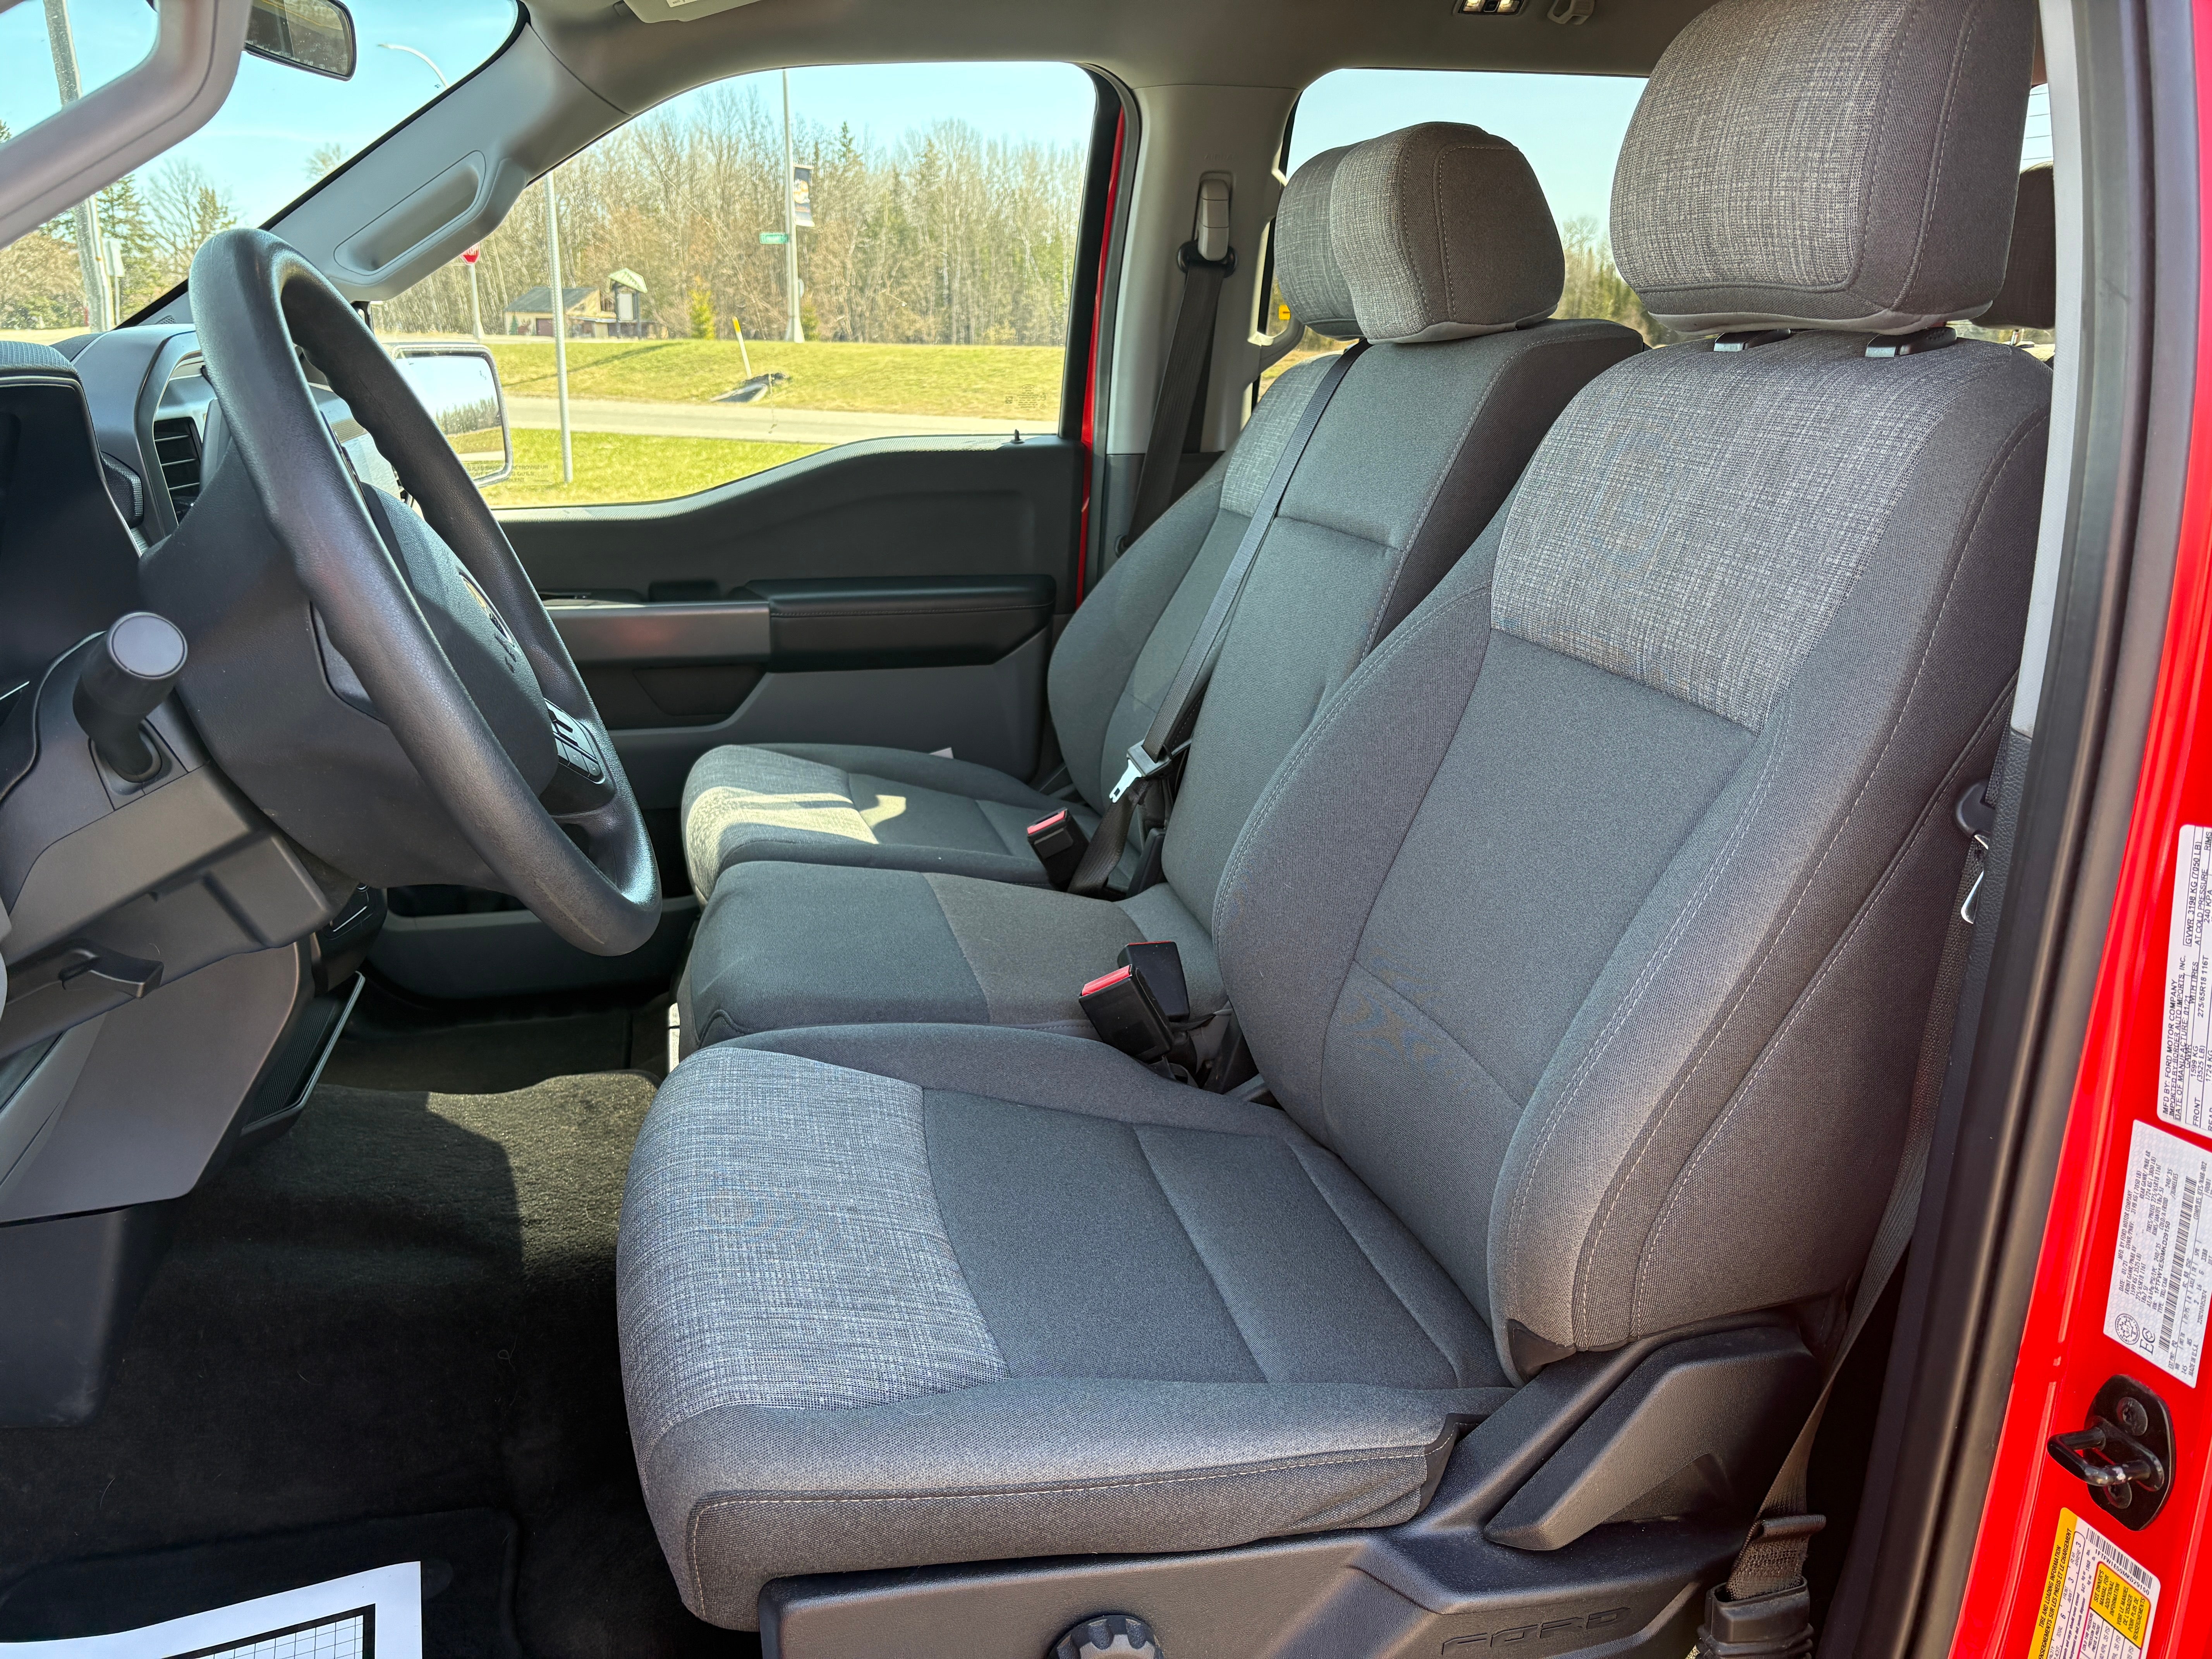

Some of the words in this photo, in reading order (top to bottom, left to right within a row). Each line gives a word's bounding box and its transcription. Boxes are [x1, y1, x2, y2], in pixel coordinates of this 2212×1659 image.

[2203, 831, 2212, 851] RIMS
[2191, 857, 2200, 879] (7050
[2190, 881, 2197, 894] KG
[2197, 868, 2208, 910] PRESSURE
[2188, 896, 2196, 915] 3198
[2185, 918, 2193, 945] GVWR
[2195, 911, 2204, 934] COLD
[2194, 934, 2202, 946] AT
[2191, 961, 2199, 982] TIRES
[2169, 979, 2177, 1021] COMPANY
[2192, 1045, 2198, 1058] KG
[2197, 976, 2207, 1018] 275/65R18
[2178, 1017, 2188, 1082] MANUFACTURE:
[2176, 1084, 2183, 1096] OF
[2059, 1527, 2073, 1565] CHARGEMENT
[2044, 1580, 2054, 1604] LOADING
[2049, 1544, 2062, 1582] INFORMATION
[2057, 1570, 2063, 1580] ET
[2059, 1563, 2064, 1572] LE
[2053, 1578, 2061, 1597] PNEUS
[2068, 1576, 2074, 1584] 3
[1441, 1606, 1631, 1656] FORD
